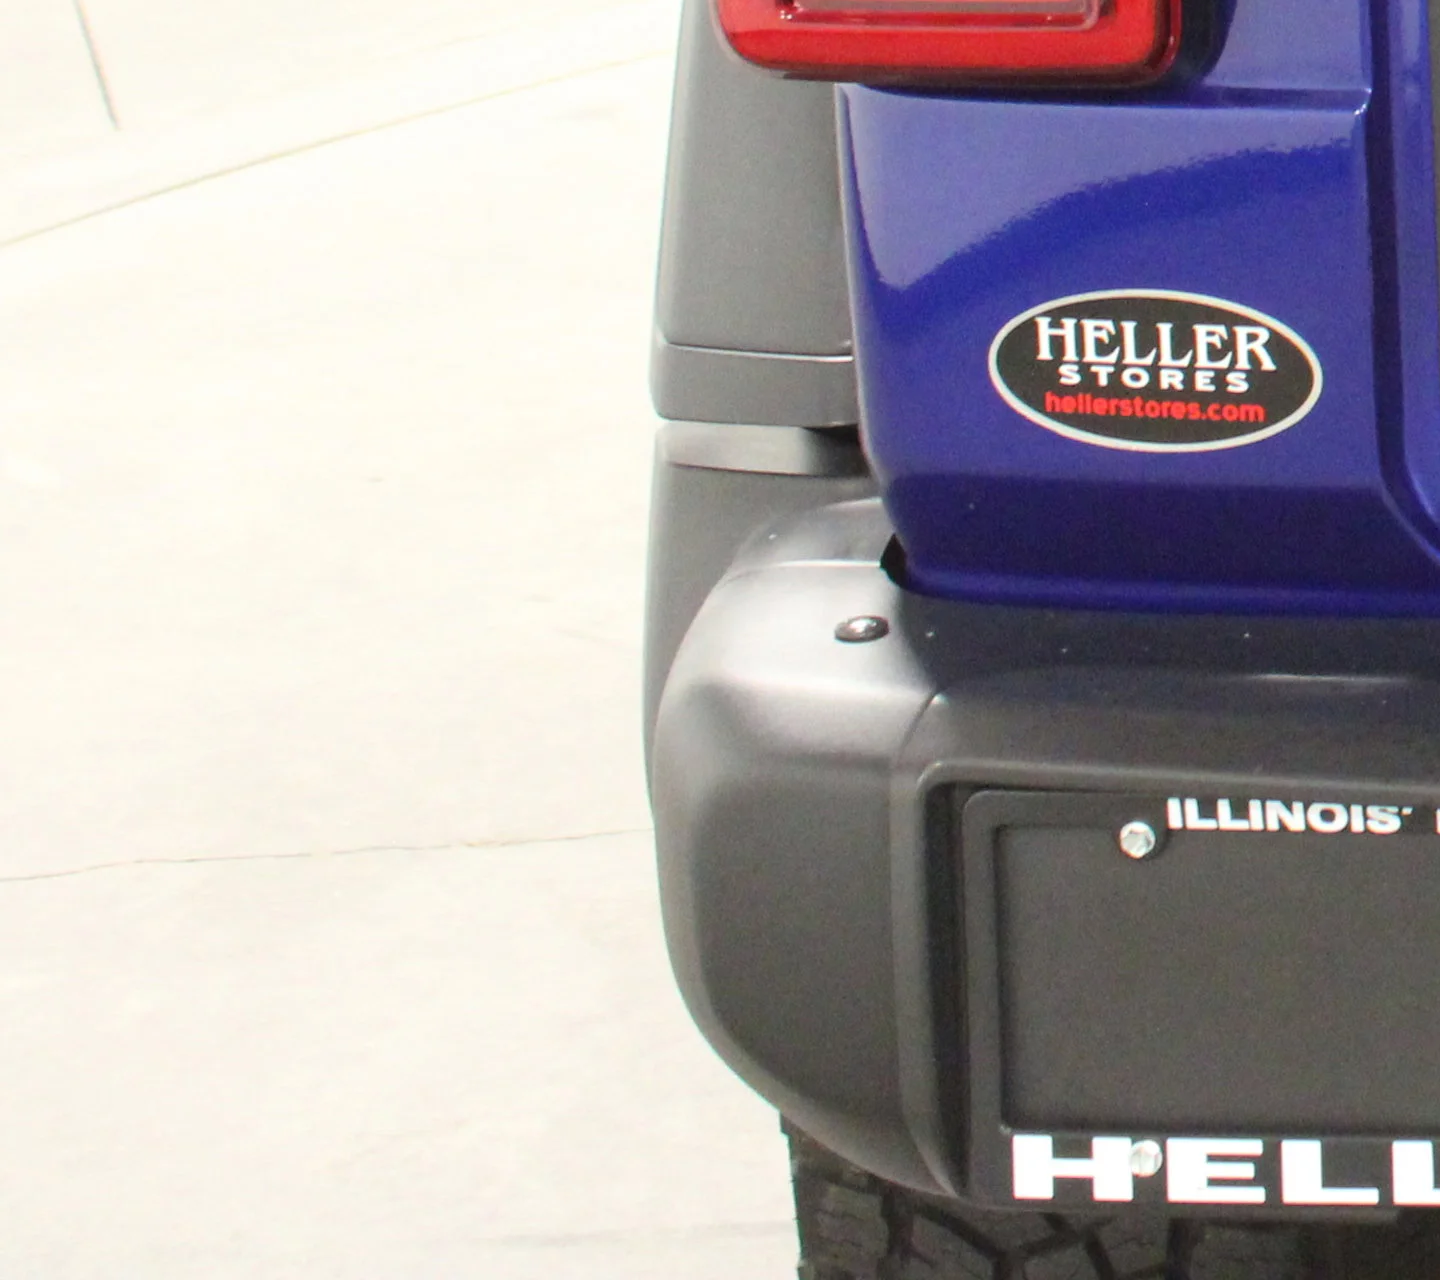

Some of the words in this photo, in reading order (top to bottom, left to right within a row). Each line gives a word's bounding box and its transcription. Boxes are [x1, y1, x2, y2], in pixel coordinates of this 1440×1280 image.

[1035, 317, 1276, 371] HELLER
[1059, 364, 1250, 393] STORES
[1045, 392, 1265, 422] hellerstores.com
[1167, 797, 1413, 834] ILLINOIS'
